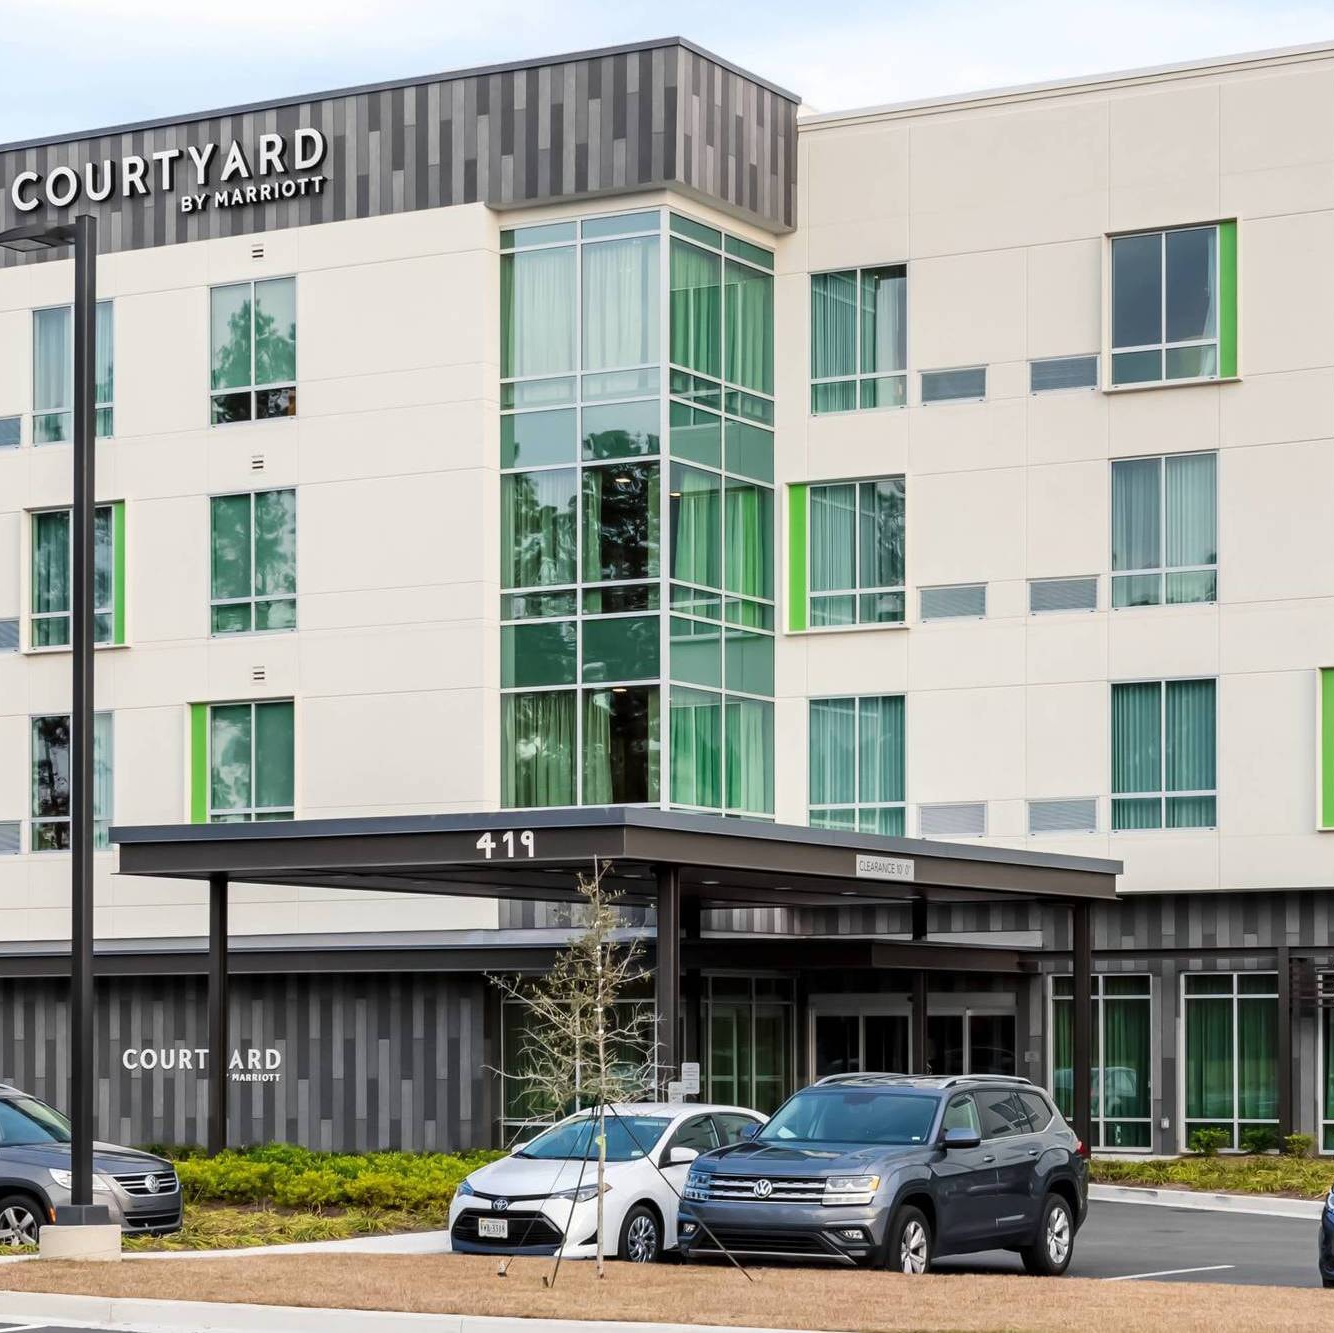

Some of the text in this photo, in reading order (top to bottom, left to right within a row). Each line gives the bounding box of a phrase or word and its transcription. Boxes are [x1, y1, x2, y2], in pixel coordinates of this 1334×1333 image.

[11, 127, 325, 212] COURTYARD
[180, 175, 324, 213] BY MARRIOTT
[476, 830, 534, 859] 419
[859, 860, 895, 874] CLEARANCE
[122, 1048, 282, 1070] COURTARD
[232, 1073, 281, 1081] MARRIOTT
